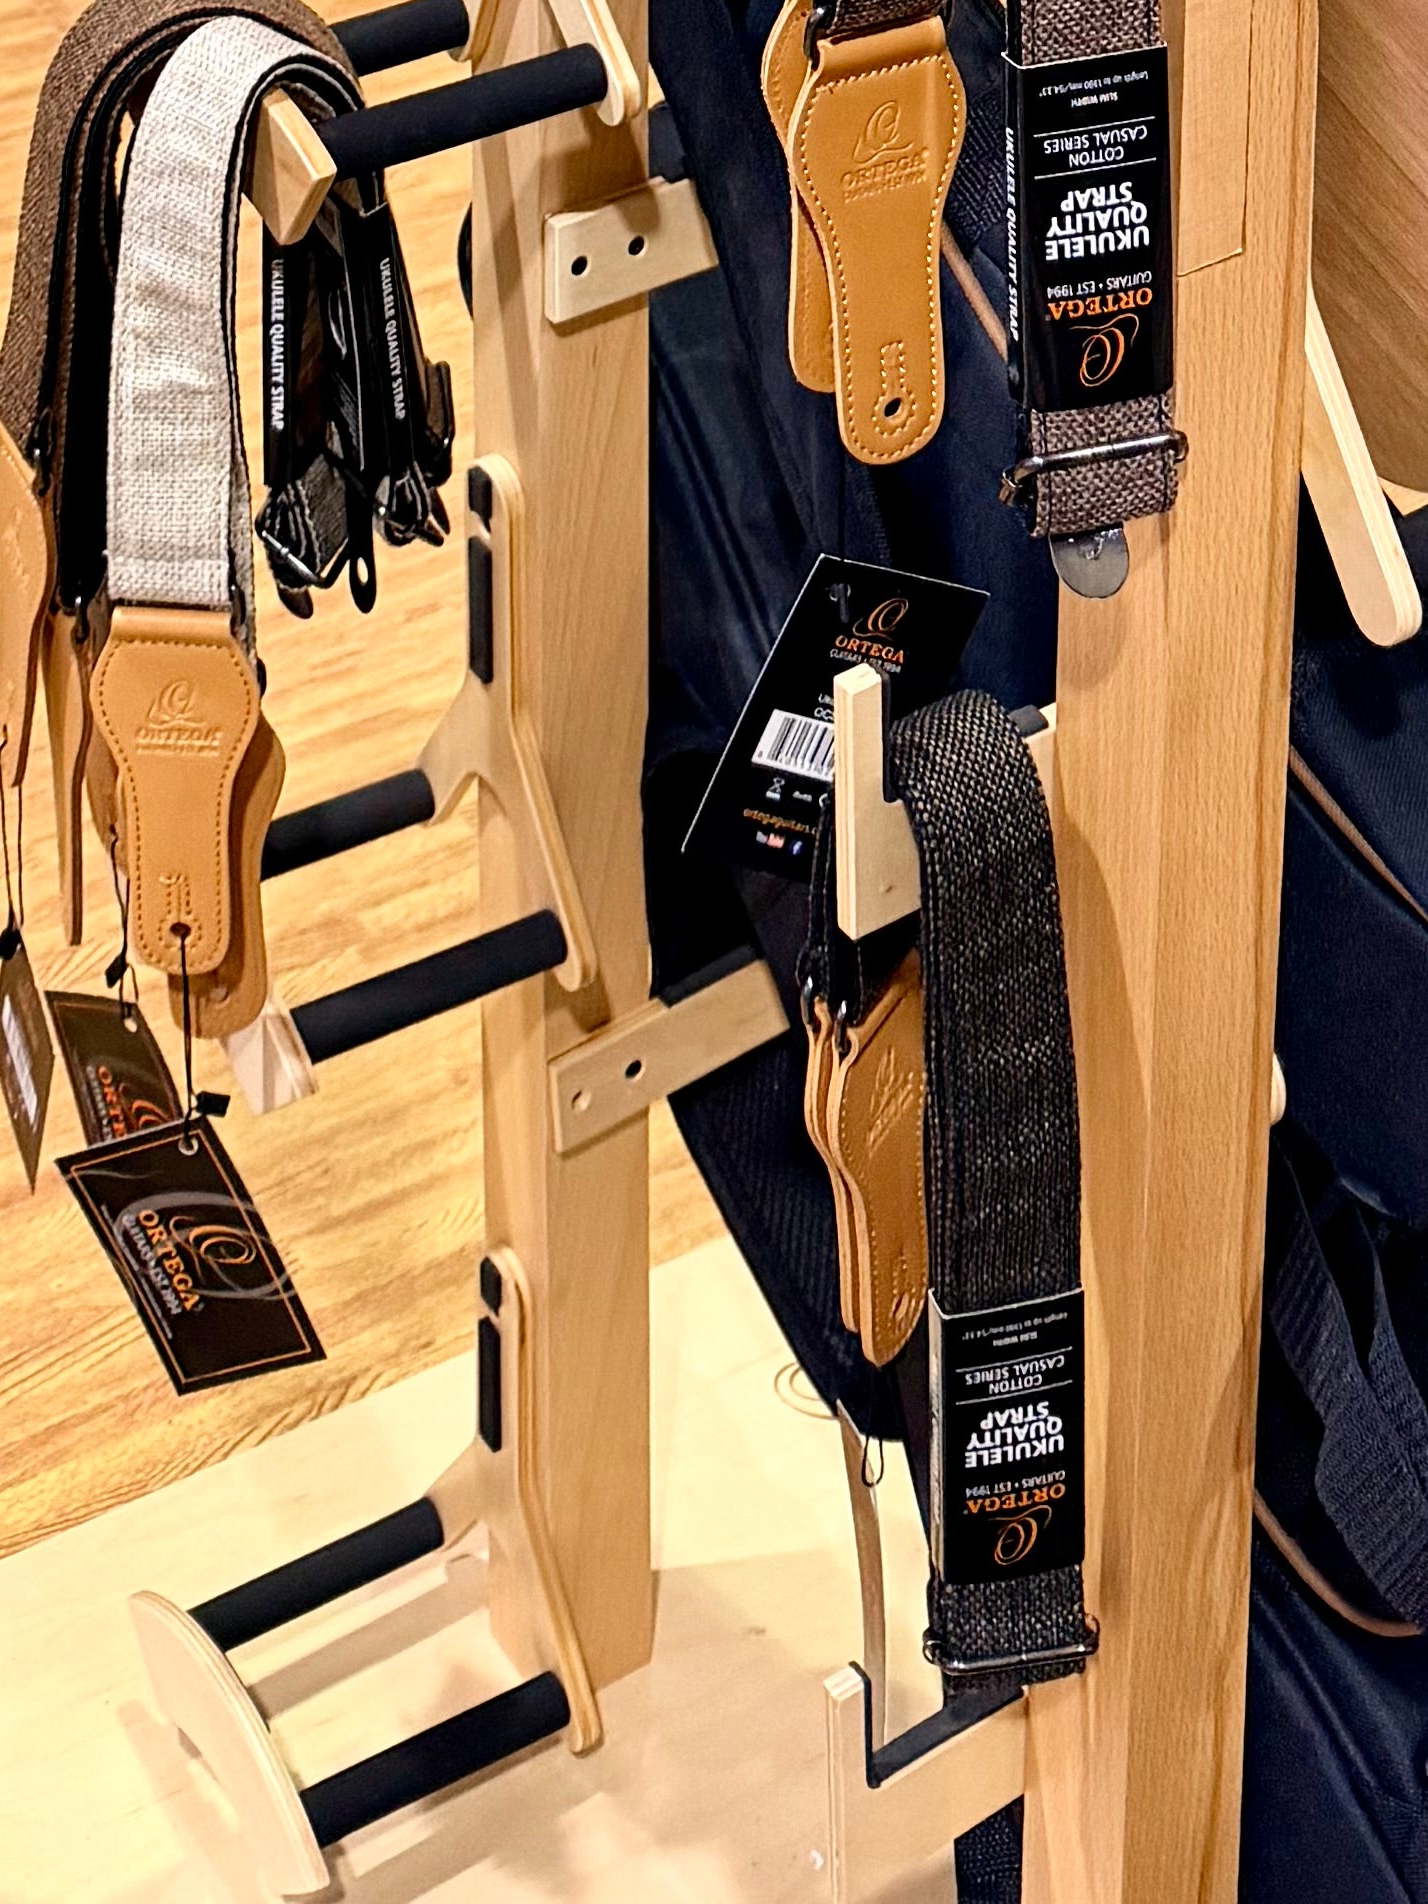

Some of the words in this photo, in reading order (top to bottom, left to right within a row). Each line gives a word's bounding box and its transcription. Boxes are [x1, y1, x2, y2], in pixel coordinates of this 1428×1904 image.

[1043, 132, 1090, 154] SERIES
[1093, 125, 1148, 150] CASUAL
[1005, 127, 1016, 206] UKULELE
[1069, 146, 1124, 167] COTTON
[1060, 181, 1133, 212] STRAP
[1046, 201, 1148, 237] QUALITY
[1006, 208, 1017, 283] QUALITY
[1045, 225, 1150, 260] UKULELE
[271, 259, 284, 321] UKULELE
[380, 258, 395, 320] UKULELE
[1046, 283, 1073, 299] 1994
[1074, 280, 1095, 295] EST
[1106, 270, 1152, 291] GUITARS
[1008, 284, 1018, 342] STRAP
[1047, 287, 1153, 318] ORTEGA
[269, 324, 284, 383] QUALITY
[385, 320, 401, 377] QUALITY
[271, 386, 284, 430] STRAP
[392, 378, 406, 420] STRAP
[835, 634, 905, 664] ORTEGA
[138, 1209, 200, 1312] ORTEGA
[965, 1366, 1009, 1385] SERIES
[1013, 1354, 1065, 1375] CASUAL
[989, 1373, 1043, 1394] COTTON
[979, 1401, 1049, 1430] STRAP
[966, 1416, 1063, 1449] QUALITY
[964, 1434, 1064, 1468] UKULELE
[994, 1481, 1011, 1495] EST
[1021, 1470, 1066, 1488] GUITARS
[965, 1482, 1066, 1513] ORTEGA
